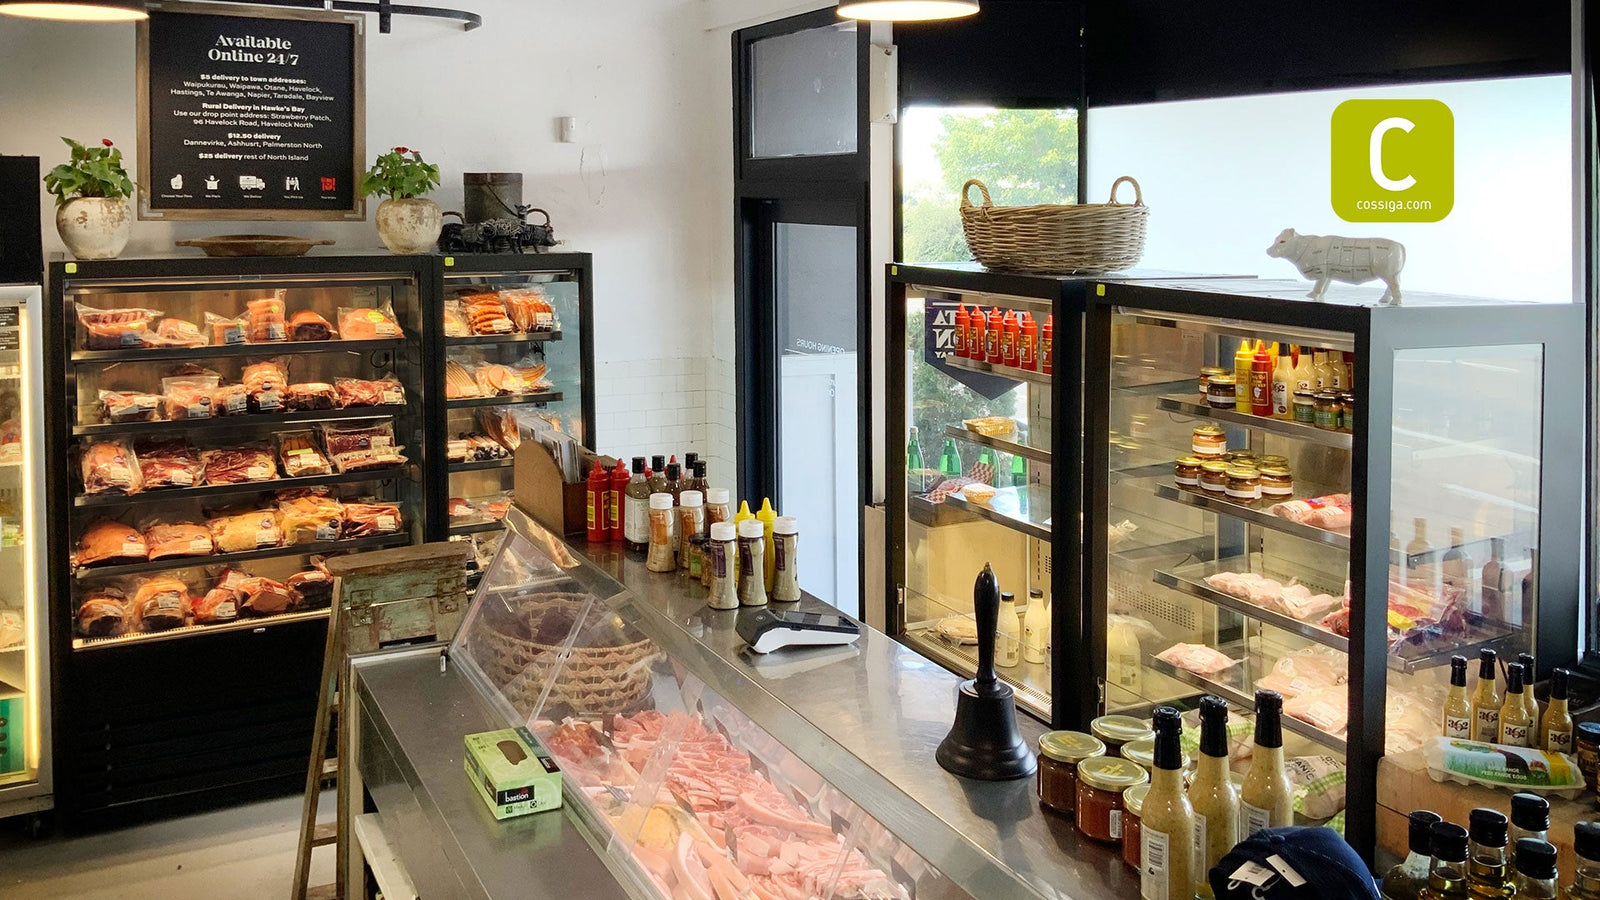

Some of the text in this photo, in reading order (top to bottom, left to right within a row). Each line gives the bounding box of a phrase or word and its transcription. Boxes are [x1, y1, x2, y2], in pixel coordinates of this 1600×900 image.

[215, 34, 292, 50] Available
[208, 48, 299, 66] Online 24/7
[211, 74, 240, 82] delivery
[183, 81, 228, 89] Waipukurau,
[229, 83, 263, 91] Waipawa,
[263, 84, 288, 92] Otane,
[170, 88, 205, 97] Hastings,
[215, 90, 246, 98] Awanga,
[273, 92, 305, 100] Taradale,
[306, 94, 334, 102] Bayview
[222, 103, 252, 111] Delivery
[291, 106, 305, 114] Bay
[202, 110, 219, 118] drop
[270, 113, 308, 121] Strawberry
[309, 114, 332, 122] Patch,
[253, 133, 281, 141] delivery
[183, 139, 226, 147] Dannevirke,
[262, 140, 302, 148] Palmerston
[303, 141, 323, 149] North
[214, 153, 243, 161] delivery
[1479, 711, 1499, 723] 362
[1447, 719, 1469, 731] 362
[1505, 726, 1526, 739] 362
[1550, 732, 1570, 744] 362
[505, 792, 529, 803] bastion
